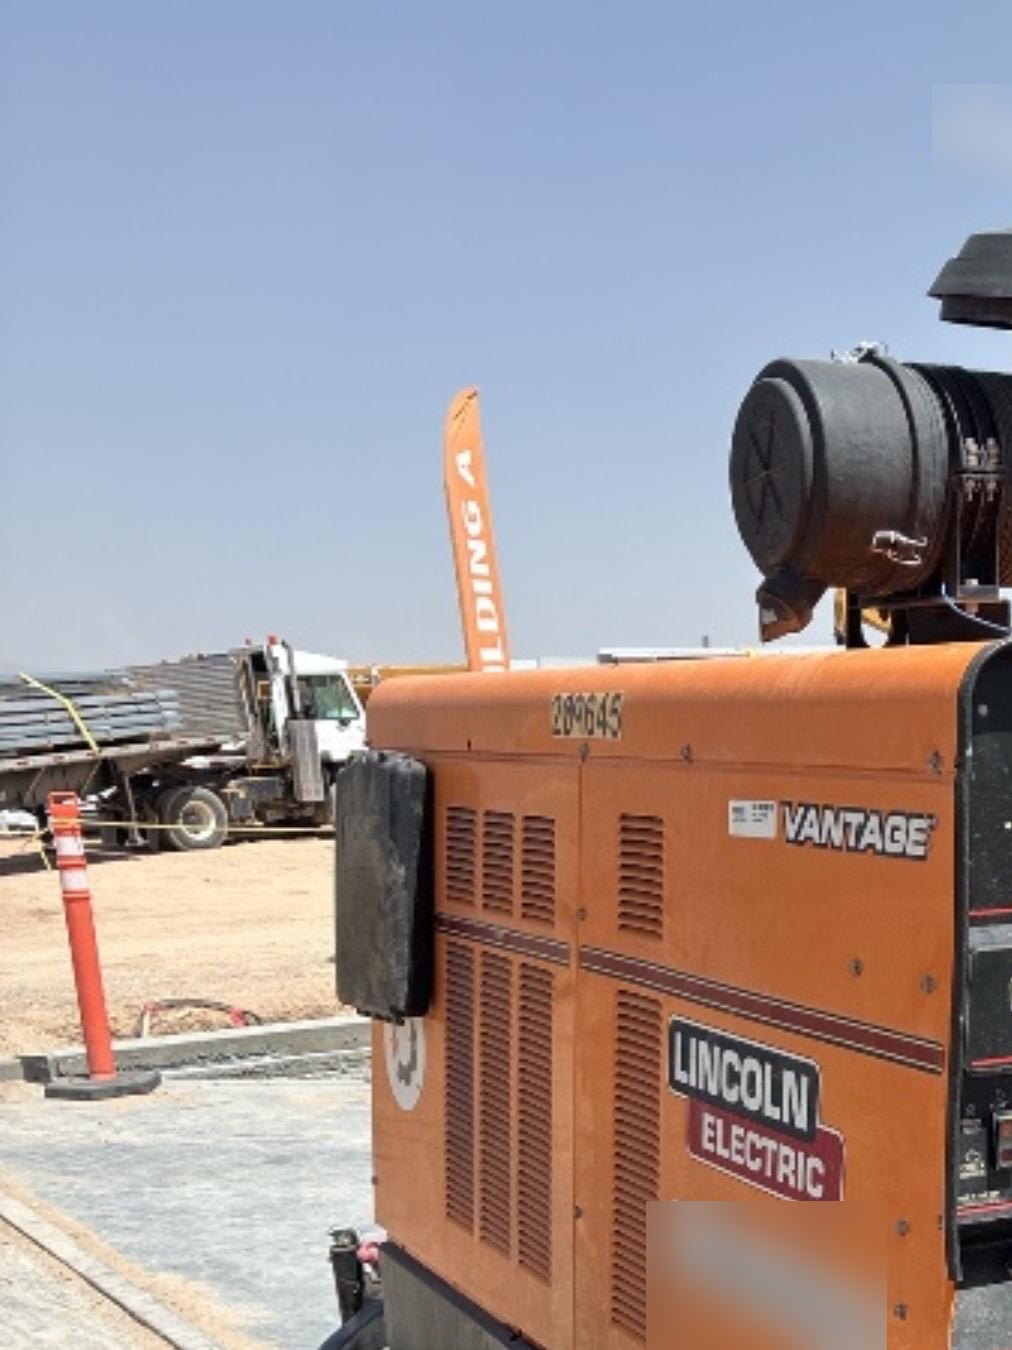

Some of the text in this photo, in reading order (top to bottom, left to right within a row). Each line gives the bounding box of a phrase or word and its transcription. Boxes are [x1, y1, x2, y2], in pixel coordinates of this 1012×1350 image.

[551, 692, 622, 738] 209645
[783, 804, 931, 859] VANTAGE
[673, 1031, 809, 1132] LINCOLN
[702, 1112, 825, 1199] ELECTRIC
